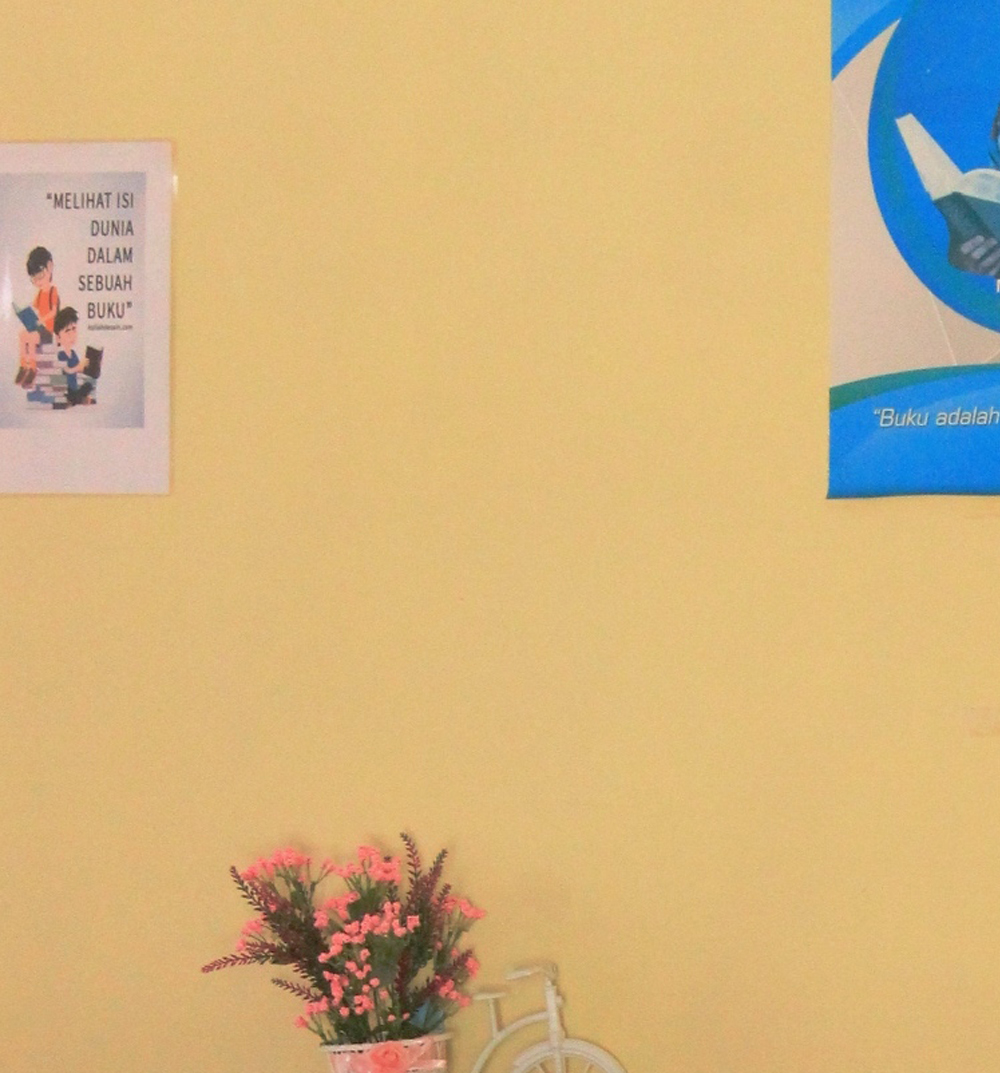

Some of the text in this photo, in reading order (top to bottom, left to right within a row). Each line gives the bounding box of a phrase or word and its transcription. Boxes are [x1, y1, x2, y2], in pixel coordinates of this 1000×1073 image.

[116, 192, 134, 209] ISI
[91, 220, 134, 236] DUNIA
[87, 247, 133, 264] DALAM
[78, 275, 132, 291] SEBUAH
[935, 406, 1000, 426] adalah
